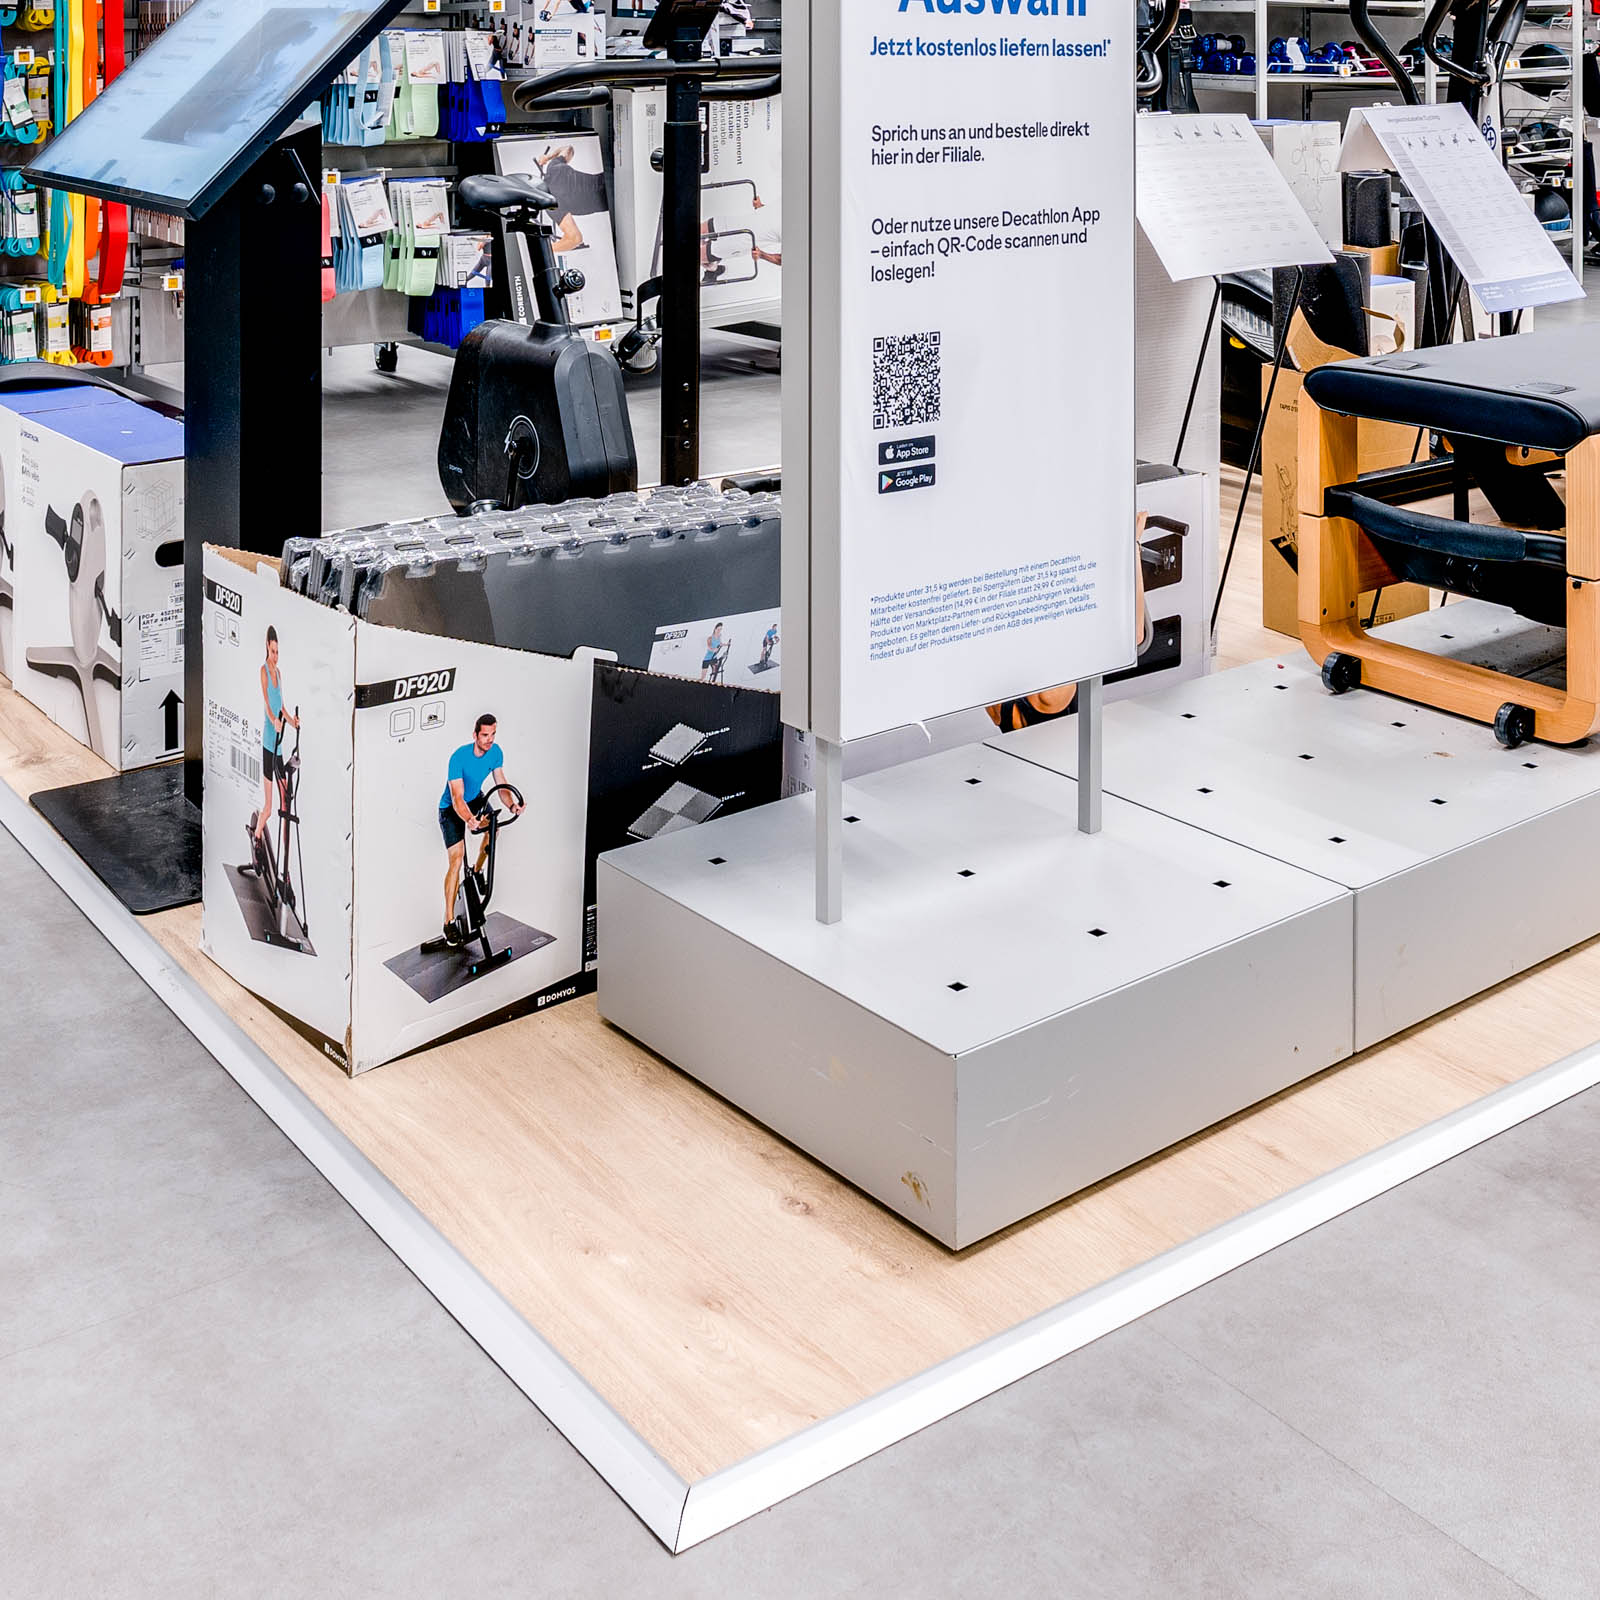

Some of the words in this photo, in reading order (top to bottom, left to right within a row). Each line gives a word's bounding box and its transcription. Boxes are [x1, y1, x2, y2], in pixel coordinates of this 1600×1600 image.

[870, 36, 913, 56] Jetzt
[916, 37, 997, 57] kostenlos
[999, 37, 1049, 57] liefern
[871, 124, 918, 146] Sprich
[920, 127, 946, 141] uns
[949, 127, 966, 140] an
[968, 123, 993, 139] und
[995, 121, 1049, 139] bestelle
[1050, 120, 1090, 137] direkt
[871, 148, 899, 165] hier
[901, 148, 913, 164] in
[916, 147, 940, 163] der
[942, 146, 985, 163] Filiale.
[871, 217, 908, 235] Oder
[911, 217, 952, 234] nutze
[953, 215, 999, 231] unsere
[1001, 208, 1075, 227] Decathlon
[1071, 206, 1101, 226] App
[881, 238, 934, 258] einfach
[937, 234, 1002, 257] QR-Code
[1004, 232, 1059, 249] scannen
[1061, 228, 1088, 245] und
[870, 261, 935, 284] loslegen!
[516, 275, 526, 318] CORENGTH
[896, 449, 911, 459] App
[911, 446, 929, 456] Store
[895, 475, 919, 487] Google
[918, 473, 933, 484] Play
[870, 603, 907, 617] Mitarbeiter
[908, 596, 941, 609] kostenfrei
[942, 588, 970, 603] geliefert.
[983, 578, 1021, 592] Sperrgütern
[1021, 575, 1036, 584] über
[1036, 570, 1049, 581] 31,5
[1058, 564, 1078, 577] sparst
[906, 588, 924, 598] unter
[939, 582, 948, 592] kg
[948, 577, 973, 589] werden
[973, 575, 984, 584] bei
[984, 567, 1018, 581] Bestellung
[1018, 564, 1029, 574] mit
[1030, 561, 1049, 572] einem
[1050, 554, 1081, 567] Decathlon
[215, 583, 242, 614] DF920
[870, 616, 891, 628] Hälfte
[892, 614, 904, 623] der
[904, 603, 954, 620] Versandkosten
[998, 588, 1017, 600] Filiale
[1017, 585, 1033, 595] statt
[870, 626, 902, 639] Produkte
[902, 623, 915, 632] von
[981, 601, 1005, 614] werden
[1018, 589, 1062, 606] unabhängigen
[1062, 581, 1096, 595] Verkäufern
[919, 628, 940, 640] gelten
[941, 623, 961, 634] deren
[981, 614, 995, 624] und
[1068, 593, 1090, 604] Details
[663, 630, 687, 641] DF920
[870, 649, 895, 661] findest
[917, 641, 929, 650] der
[930, 631, 972, 648] Produktseite
[972, 627, 985, 637] und
[993, 623, 1006, 632] den
[1006, 619, 1021, 629] AGB
[1021, 617, 1033, 626] des
[1033, 609, 1065, 625] jeweiligen
[393, 669, 452, 701] DF920
[545, 986, 577, 1005] DOMYOS
